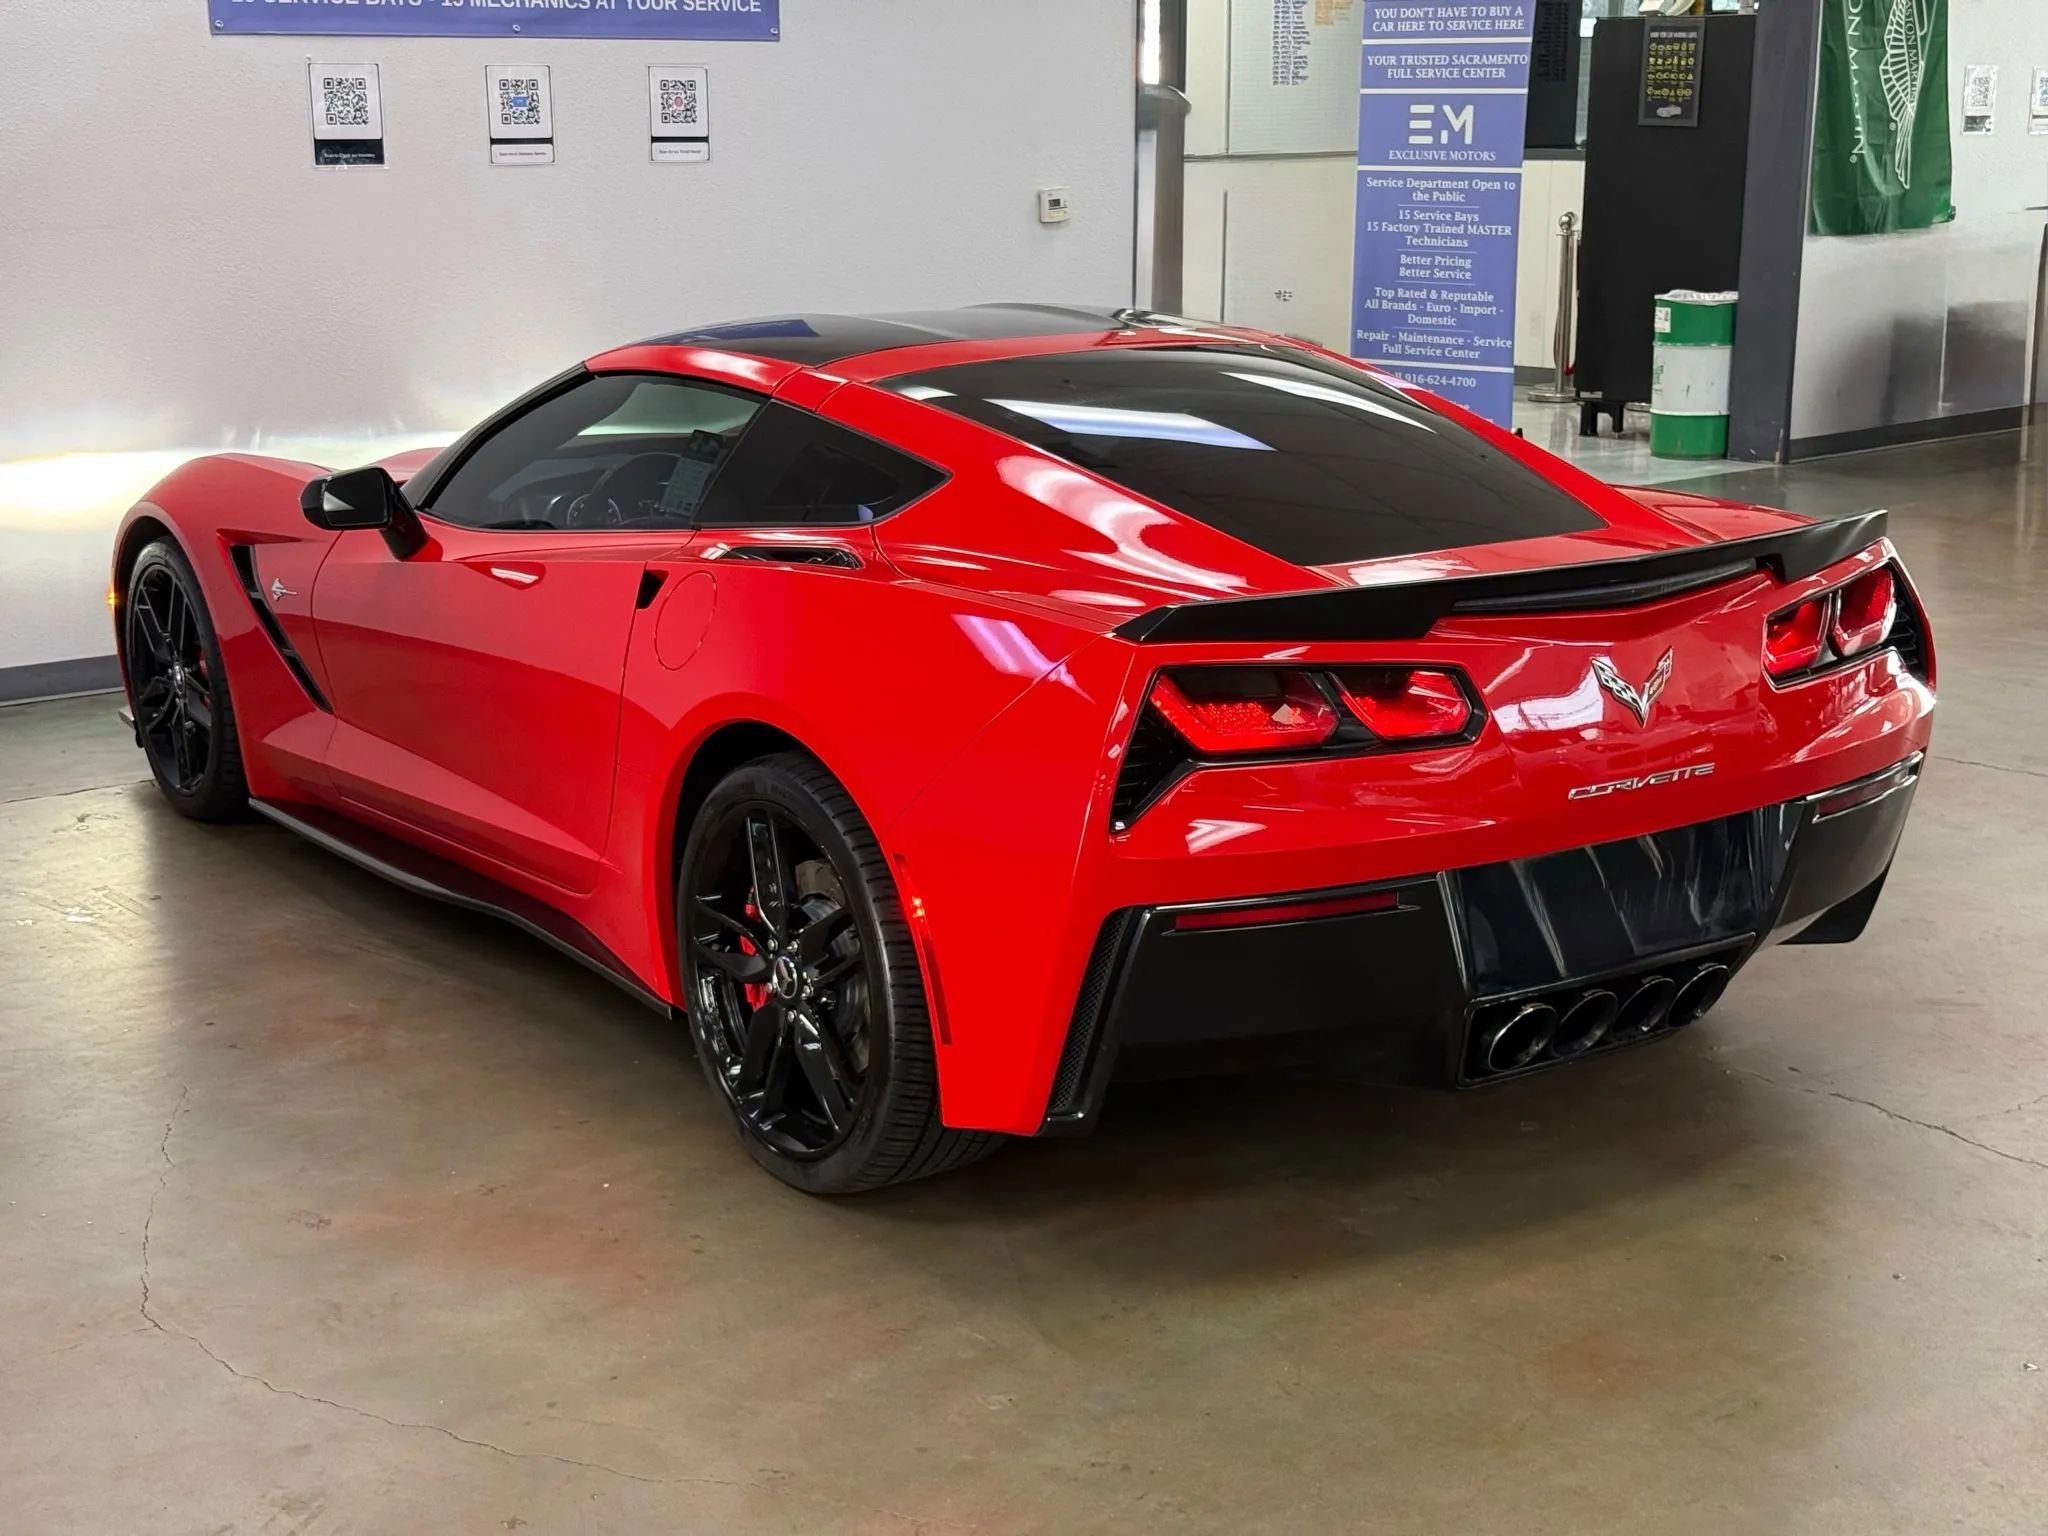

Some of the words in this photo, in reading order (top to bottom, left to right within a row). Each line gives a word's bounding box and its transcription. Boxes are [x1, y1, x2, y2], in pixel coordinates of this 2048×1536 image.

[683, 0, 762, 12] SERVICE
[1375, 8, 1397, 19] YOU
[1400, 8, 1433, 19] DON'T
[1438, 7, 1467, 18] HAVE
[1471, 7, 1486, 18] TO
[1489, 6, 1512, 17] BUY
[1515, 6, 1524, 17] A
[1372, 21, 1395, 32] CAR
[1397, 21, 1426, 32] HERE
[1428, 21, 1444, 32] TO
[1447, 20, 1492, 31] SERVICE
[1495, 19, 1525, 31] HERE
[1368, 56, 1397, 66] YOUR
[1400, 55, 1450, 66] TRUSTED
[1452, 54, 1528, 66] SACRAMENTO
[1387, 68, 1413, 79] FULL
[1416, 68, 1460, 79] SERVICE
[1462, 67, 1506, 79] CENTER
[1389, 150, 1448, 161] EXCLUSIVE
[1450, 151, 1497, 162] MOTORS
[1367, 177, 1404, 188] Service
[1406, 178, 1469, 191] Department
[1472, 179, 1500, 192] Open
[1504, 180, 1516, 190] to
[1412, 191, 1430, 202] the
[1432, 191, 1466, 203] Public
[1399, 210, 1411, 221] 15
[1413, 211, 1453, 222] Service
[1454, 211, 1480, 224] Bays
[1367, 221, 1379, 232] 15
[1381, 222, 1421, 235] Factory
[1423, 223, 1465, 235] Trained
[1467, 225, 1513, 236] MASTER
[1405, 236, 1469, 248] Technicians
[1400, 255, 1432, 266] Better
[1434, 256, 1473, 269] Pricing
[1399, 267, 1432, 278] Better
[1433, 269, 1472, 280] Service
[1375, 287, 1395, 299] Top
[1397, 288, 1428, 300] Rated
[1429, 289, 1439, 300] &
[1440, 290, 1495, 304] Reputable
[1364, 299, 1379, 309] All
[1381, 300, 1417, 311] Brands
[1426, 302, 1451, 313] Euro
[1460, 304, 1497, 317] Import
[1408, 314, 1457, 327] Domestic
[1357, 330, 1390, 342] Repair
[1398, 332, 1465, 346] Maintenance
[1473, 336, 1513, 349] Service
[1382, 343, 1402, 354] Full
[1404, 345, 1442, 357] Service
[1444, 347, 1481, 360] Center
[1404, 373, 1477, 388] 916-624-4700
[1568, 762, 1716, 800] CORVETTE
